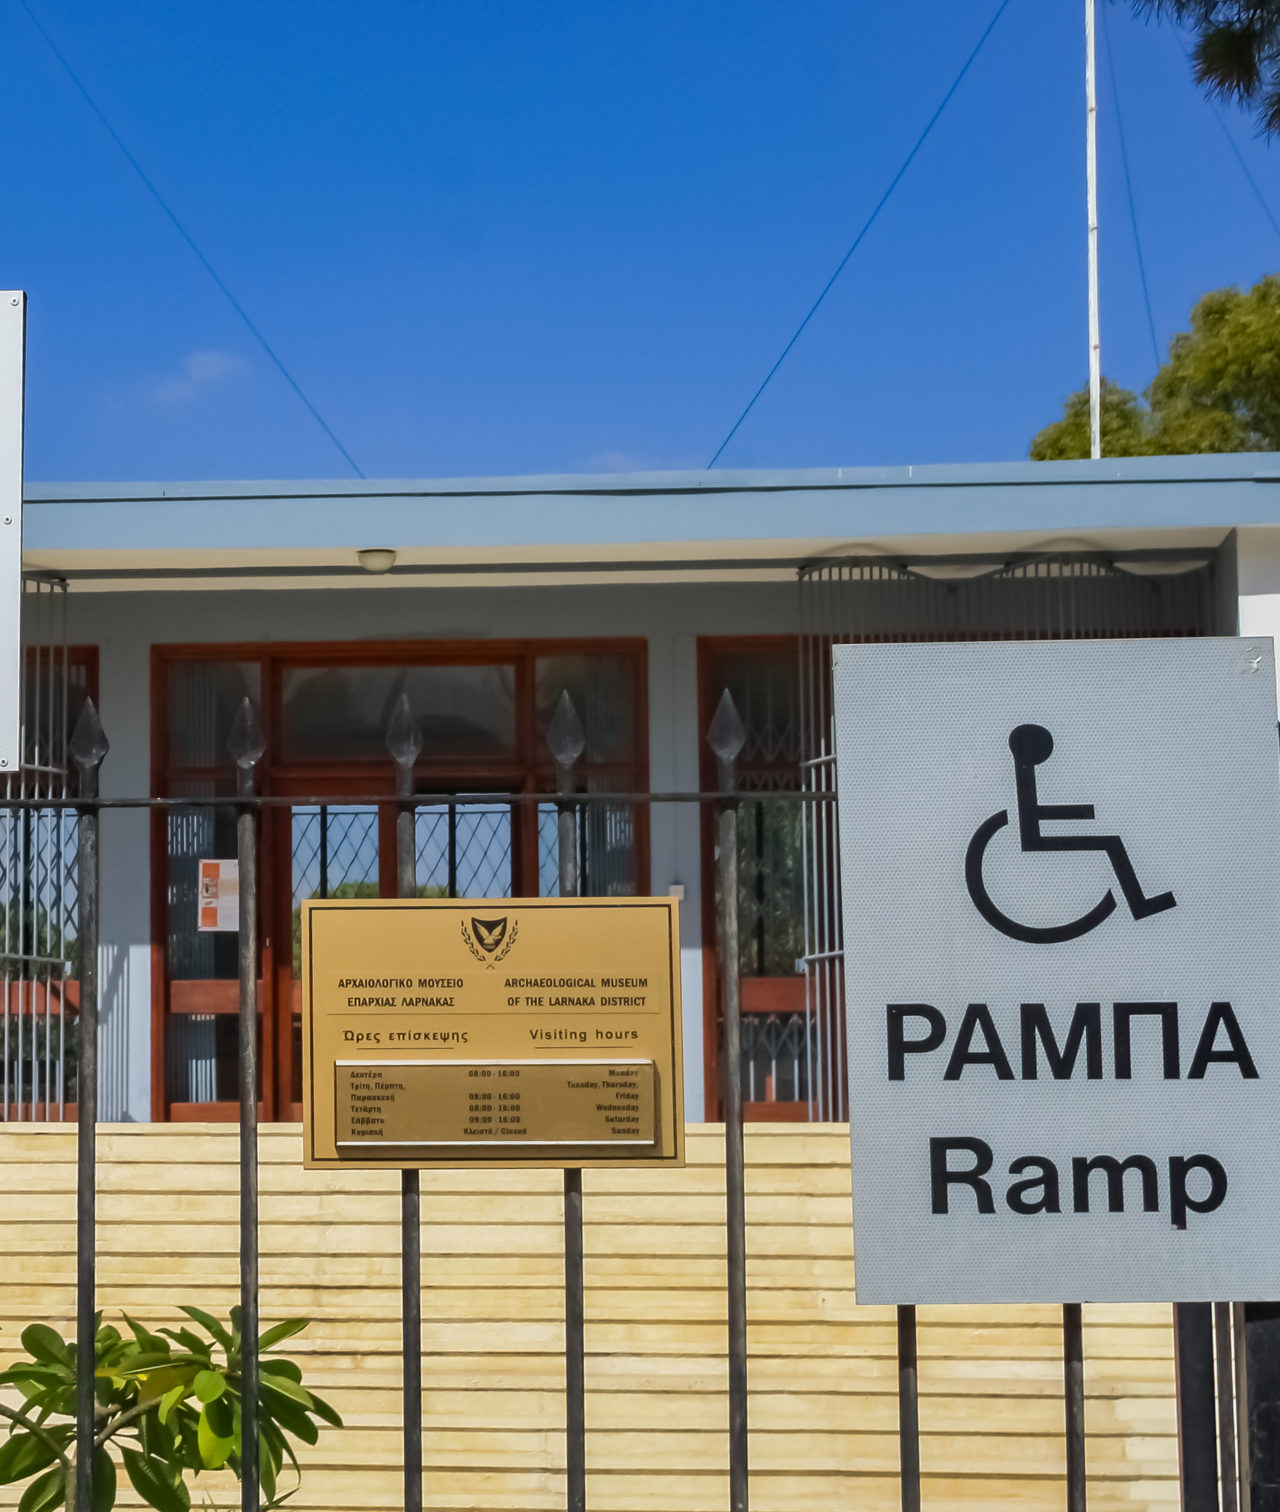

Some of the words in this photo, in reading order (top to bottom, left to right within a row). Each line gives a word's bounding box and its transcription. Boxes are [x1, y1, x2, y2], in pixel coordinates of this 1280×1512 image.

[337, 978, 413, 989] ΑΡΧΑΙΟΛΟΓΙΚΟ
[418, 978, 464, 989] ΜΟΥΣΕΙΟ
[504, 977, 597, 988] ARCHAEOLOGICAL
[600, 977, 648, 988] MUSEUM
[347, 997, 397, 1007] ΕΠΑΡΧΙΑΣ
[401, 996, 455, 1007] ΛΑΡΝΑΚΑΣ
[507, 996, 521, 1007] OF
[525, 996, 544, 1007] THE
[548, 996, 596, 1007] LARNAKA
[600, 996, 647, 1007] DISTRICT
[388, 1029, 469, 1044] επίσκεψης
[529, 1028, 588, 1043] Visiting
[595, 1028, 639, 1040] hours
[885, 1001, 1261, 1081] ΡΑΜΠΑ
[928, 1135, 1229, 1231] Ramp
